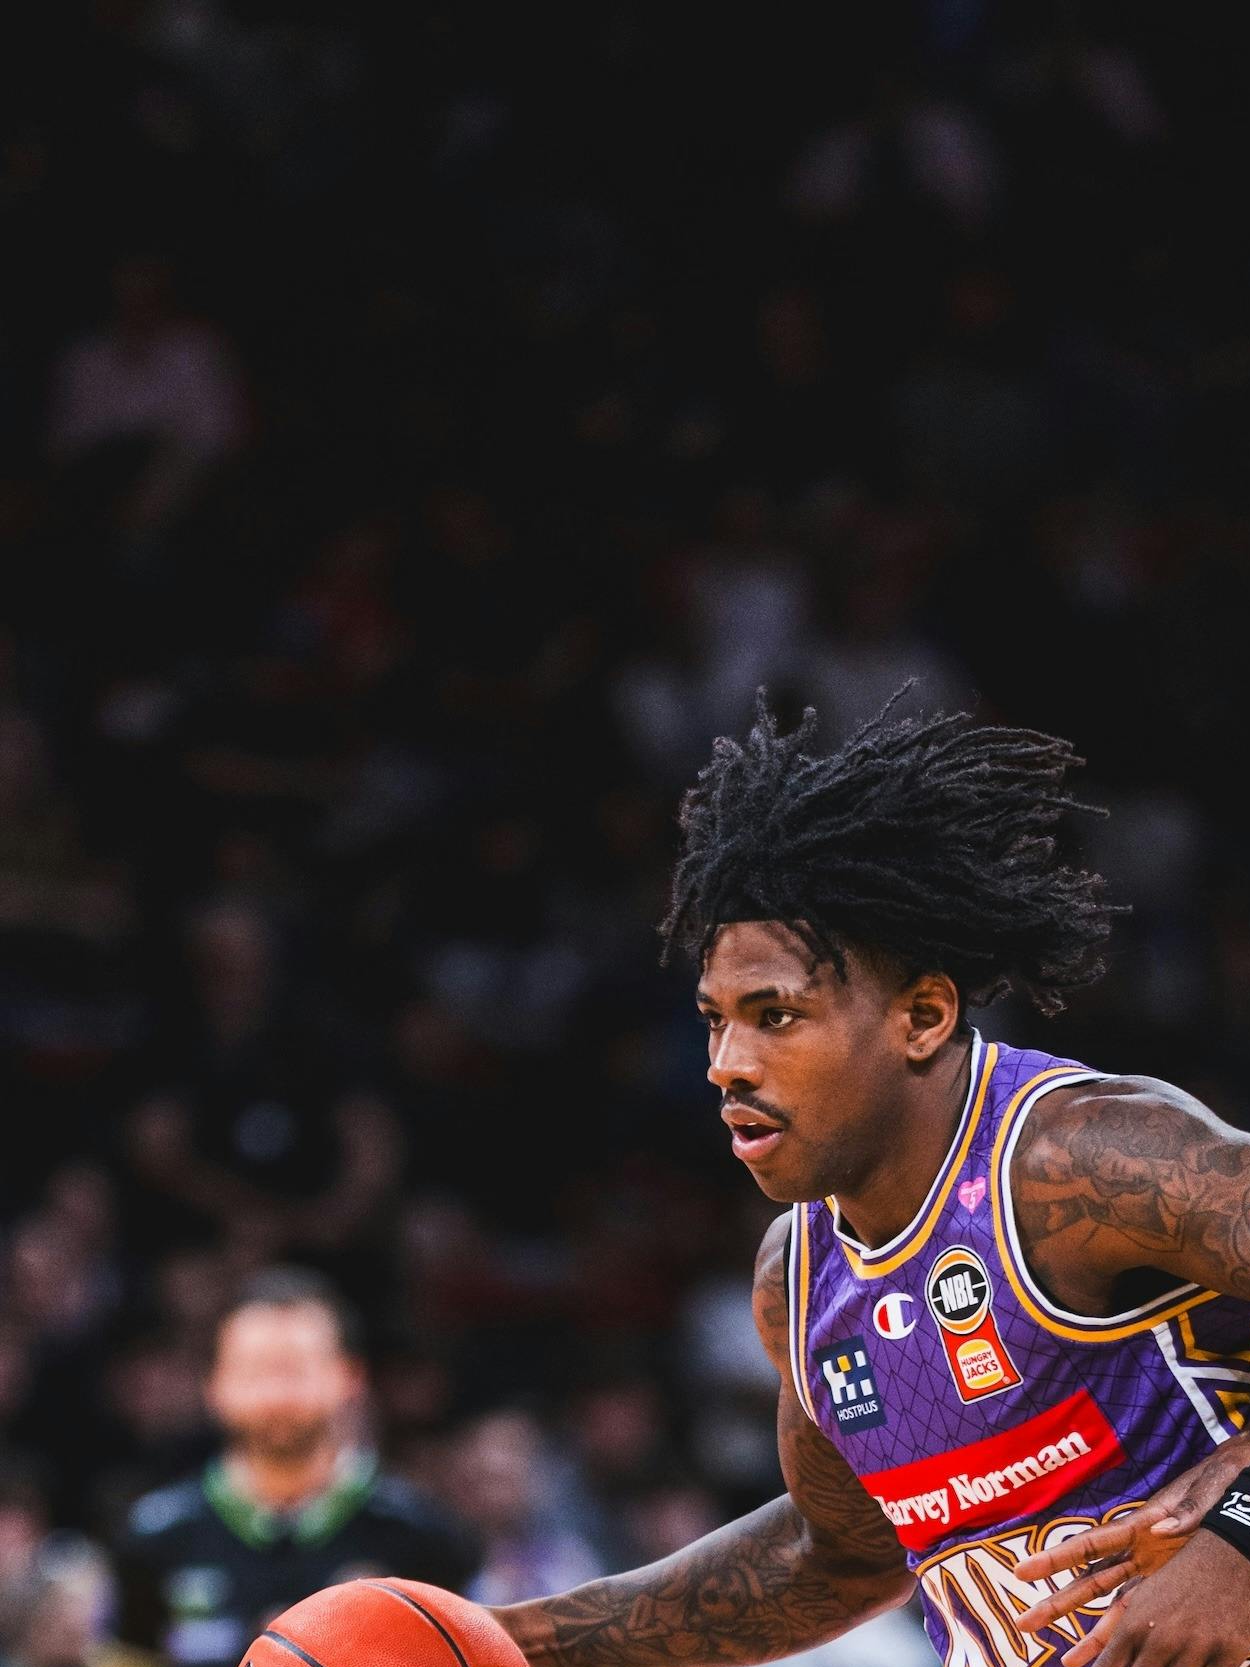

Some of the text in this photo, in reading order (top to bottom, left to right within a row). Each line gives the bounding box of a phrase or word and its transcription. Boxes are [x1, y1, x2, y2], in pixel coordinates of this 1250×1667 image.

[938, 1271, 979, 1314] NBL
[961, 1350, 993, 1368] HUNGRY
[837, 1400, 879, 1422] HOSTPLUS
[948, 1431, 1092, 1510] Norman
